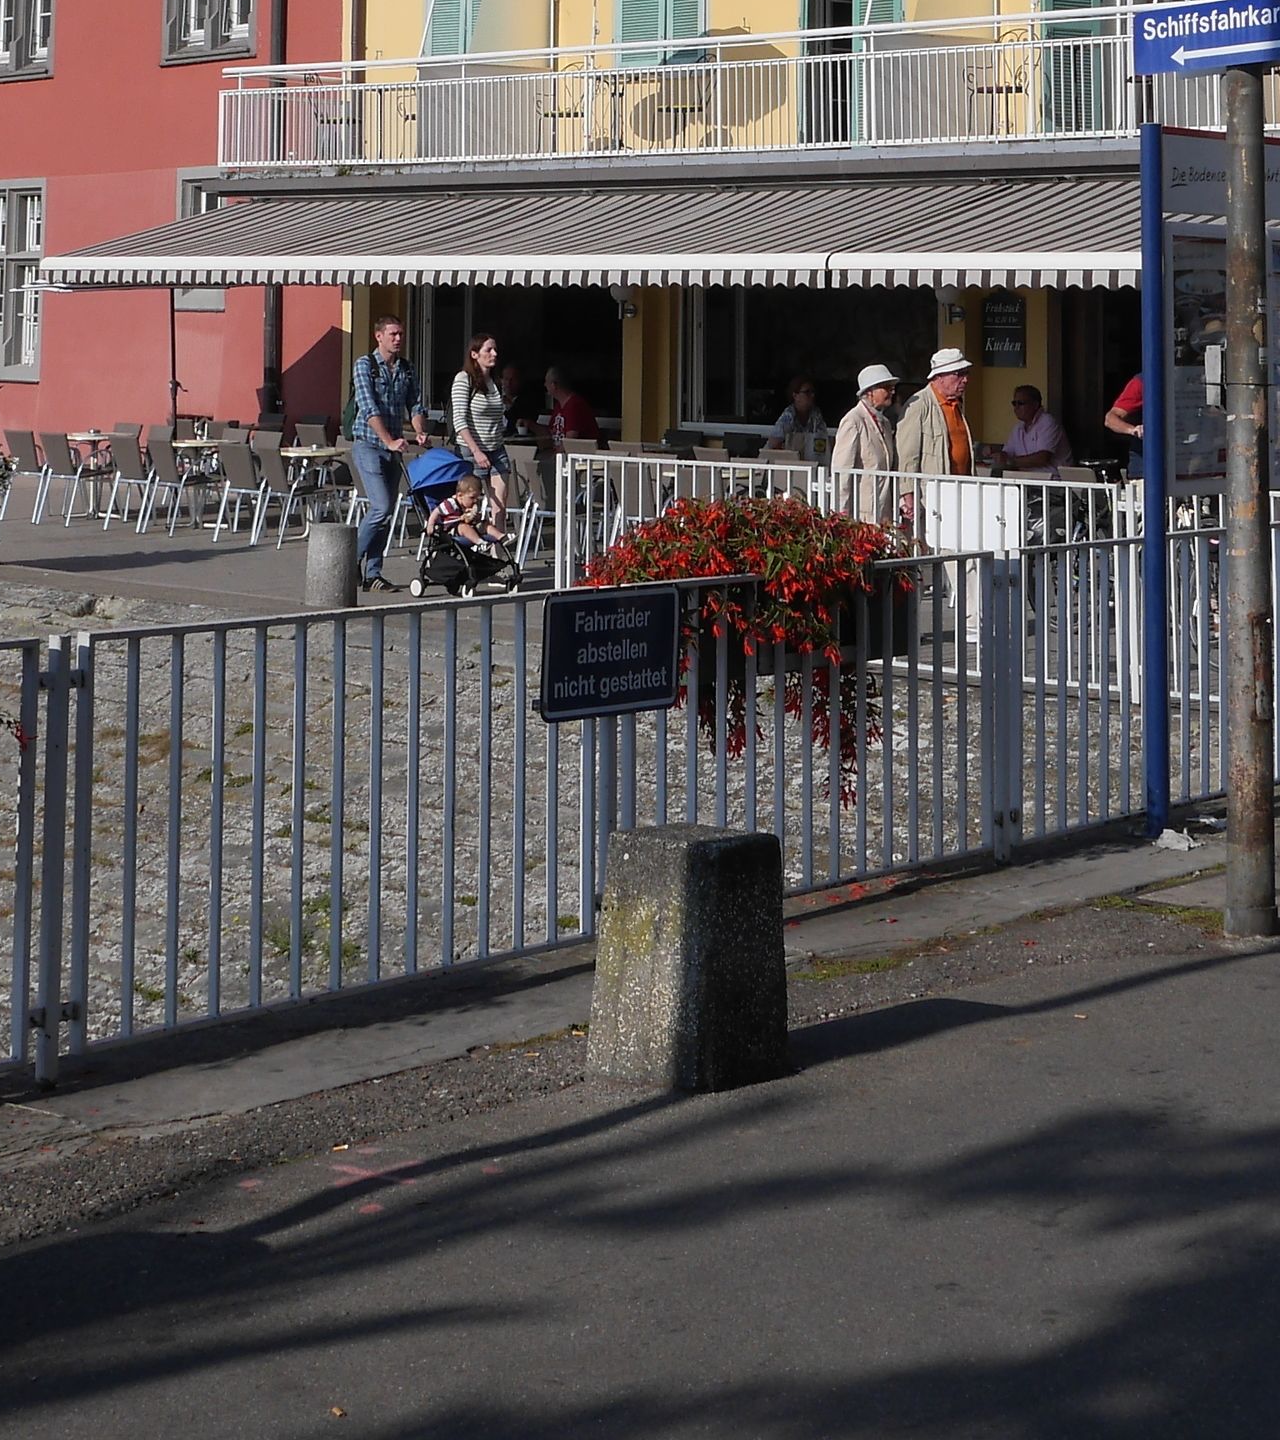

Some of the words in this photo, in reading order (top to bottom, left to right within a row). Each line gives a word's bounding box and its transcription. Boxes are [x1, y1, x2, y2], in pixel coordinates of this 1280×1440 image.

[1172, 166, 1186, 183] Die
[985, 337, 1021, 351] Kuchen
[575, 608, 651, 633] Fahrräder
[577, 639, 647, 664] abstellen
[554, 674, 596, 699] nicht
[600, 666, 667, 699] gestattet
